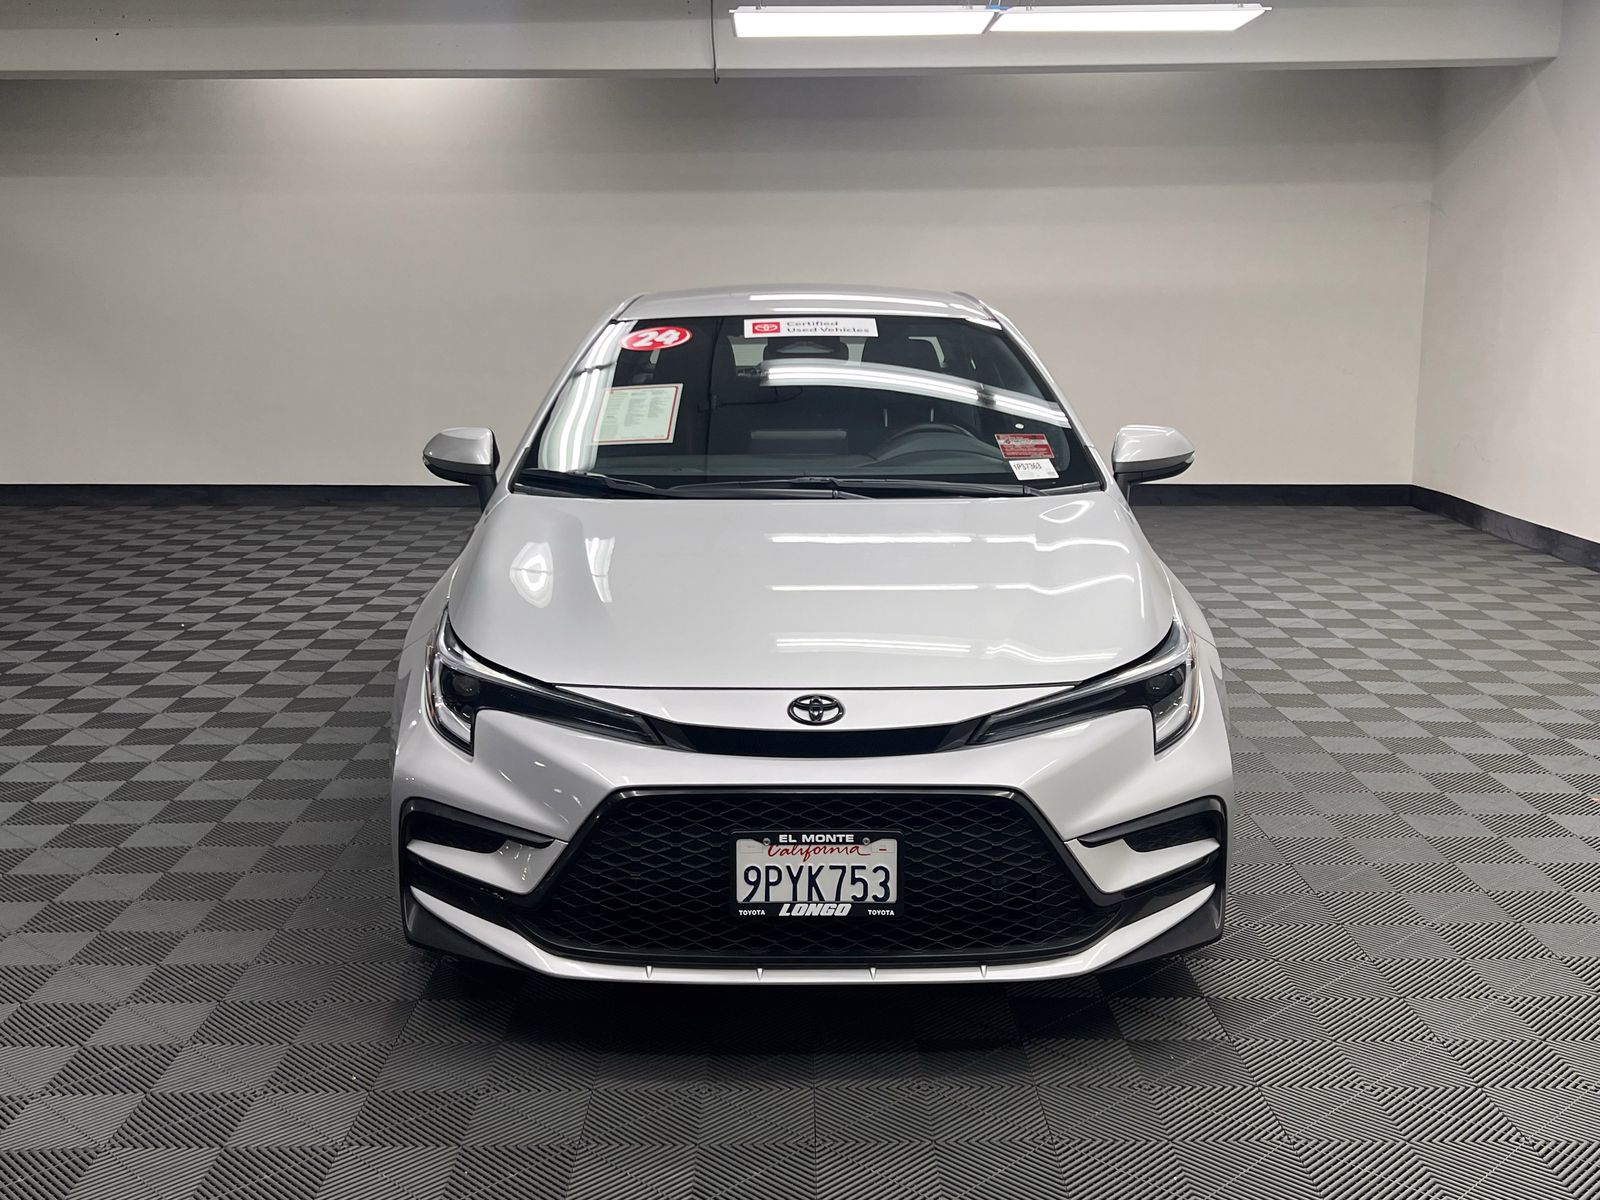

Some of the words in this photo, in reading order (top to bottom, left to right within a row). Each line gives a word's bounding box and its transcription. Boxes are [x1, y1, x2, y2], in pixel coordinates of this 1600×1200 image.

[632, 329, 681, 348] 24
[779, 834, 797, 843] EL
[801, 834, 855, 843] MONTE
[767, 844, 871, 863] California
[742, 865, 891, 903] 9PYK753
[778, 903, 852, 917] LONGO
